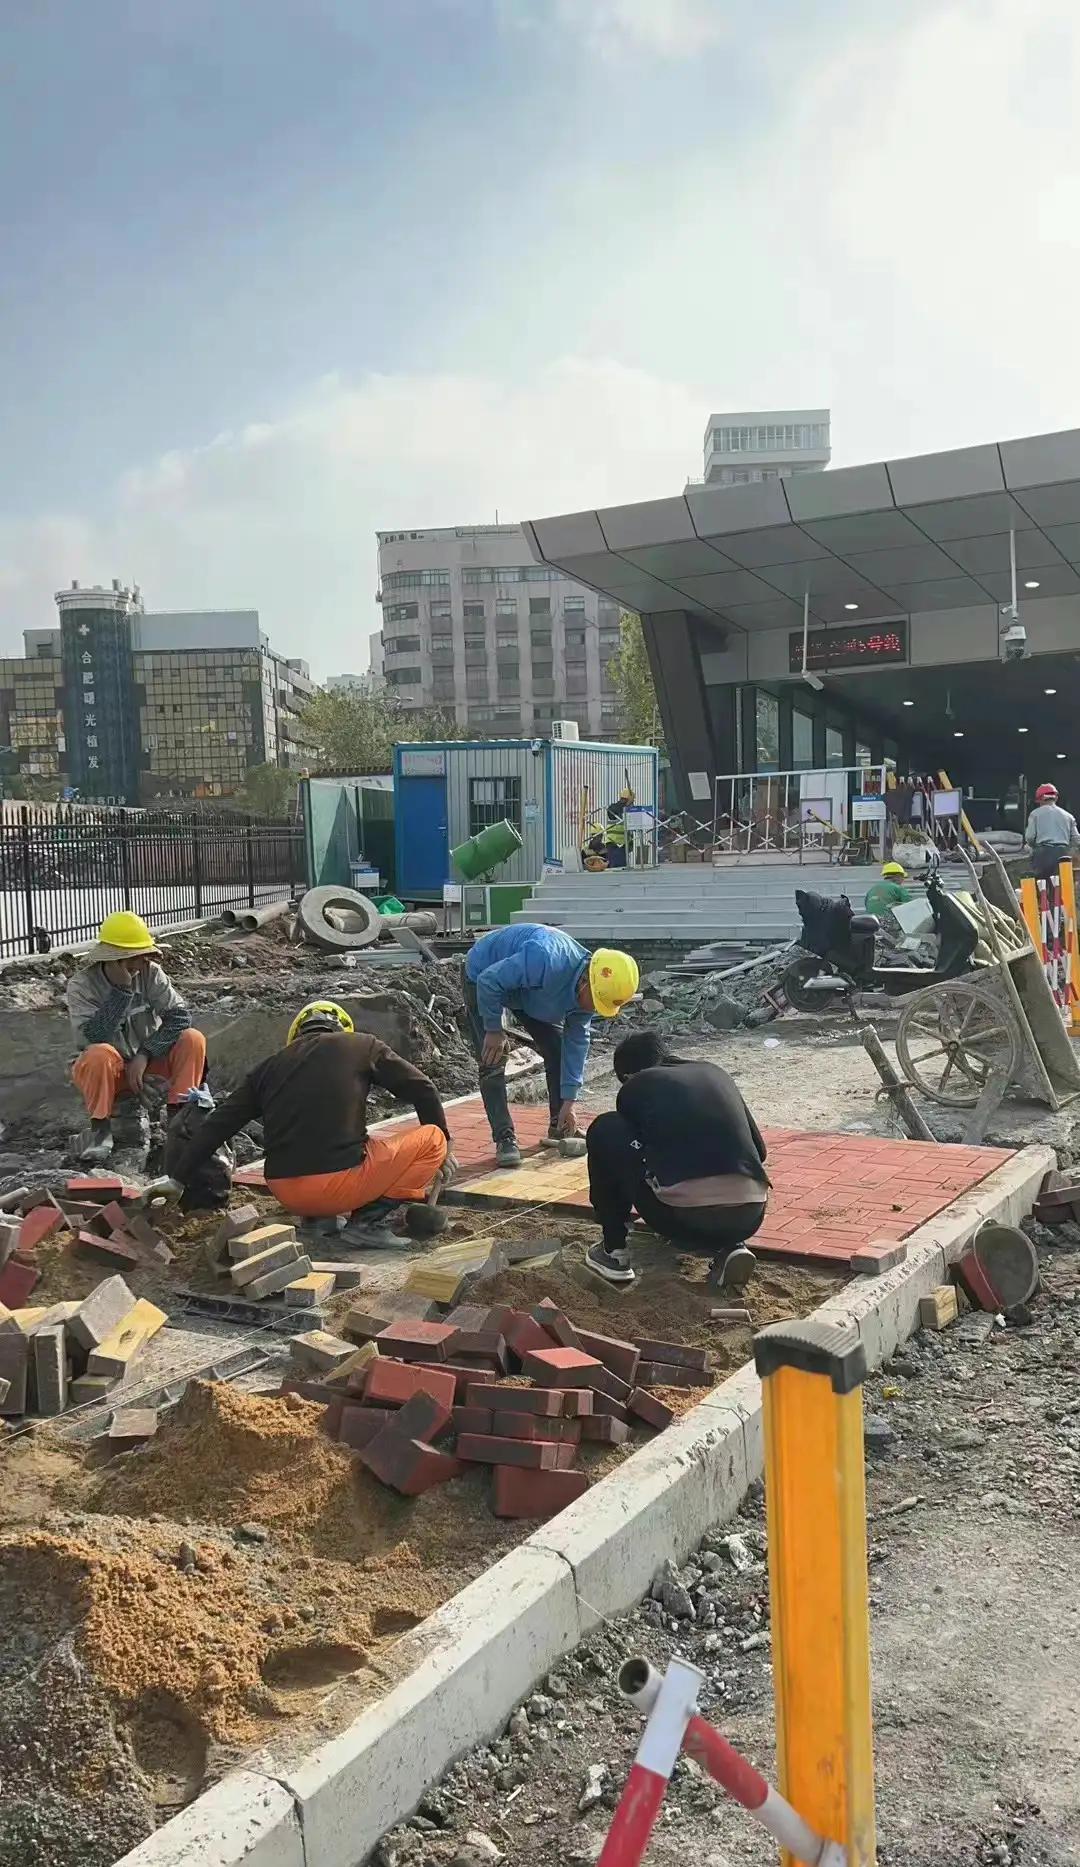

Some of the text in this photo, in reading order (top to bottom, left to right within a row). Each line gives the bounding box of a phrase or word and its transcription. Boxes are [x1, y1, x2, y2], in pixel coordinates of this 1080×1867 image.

[81, 650, 100, 769] 合肥曙光植发
